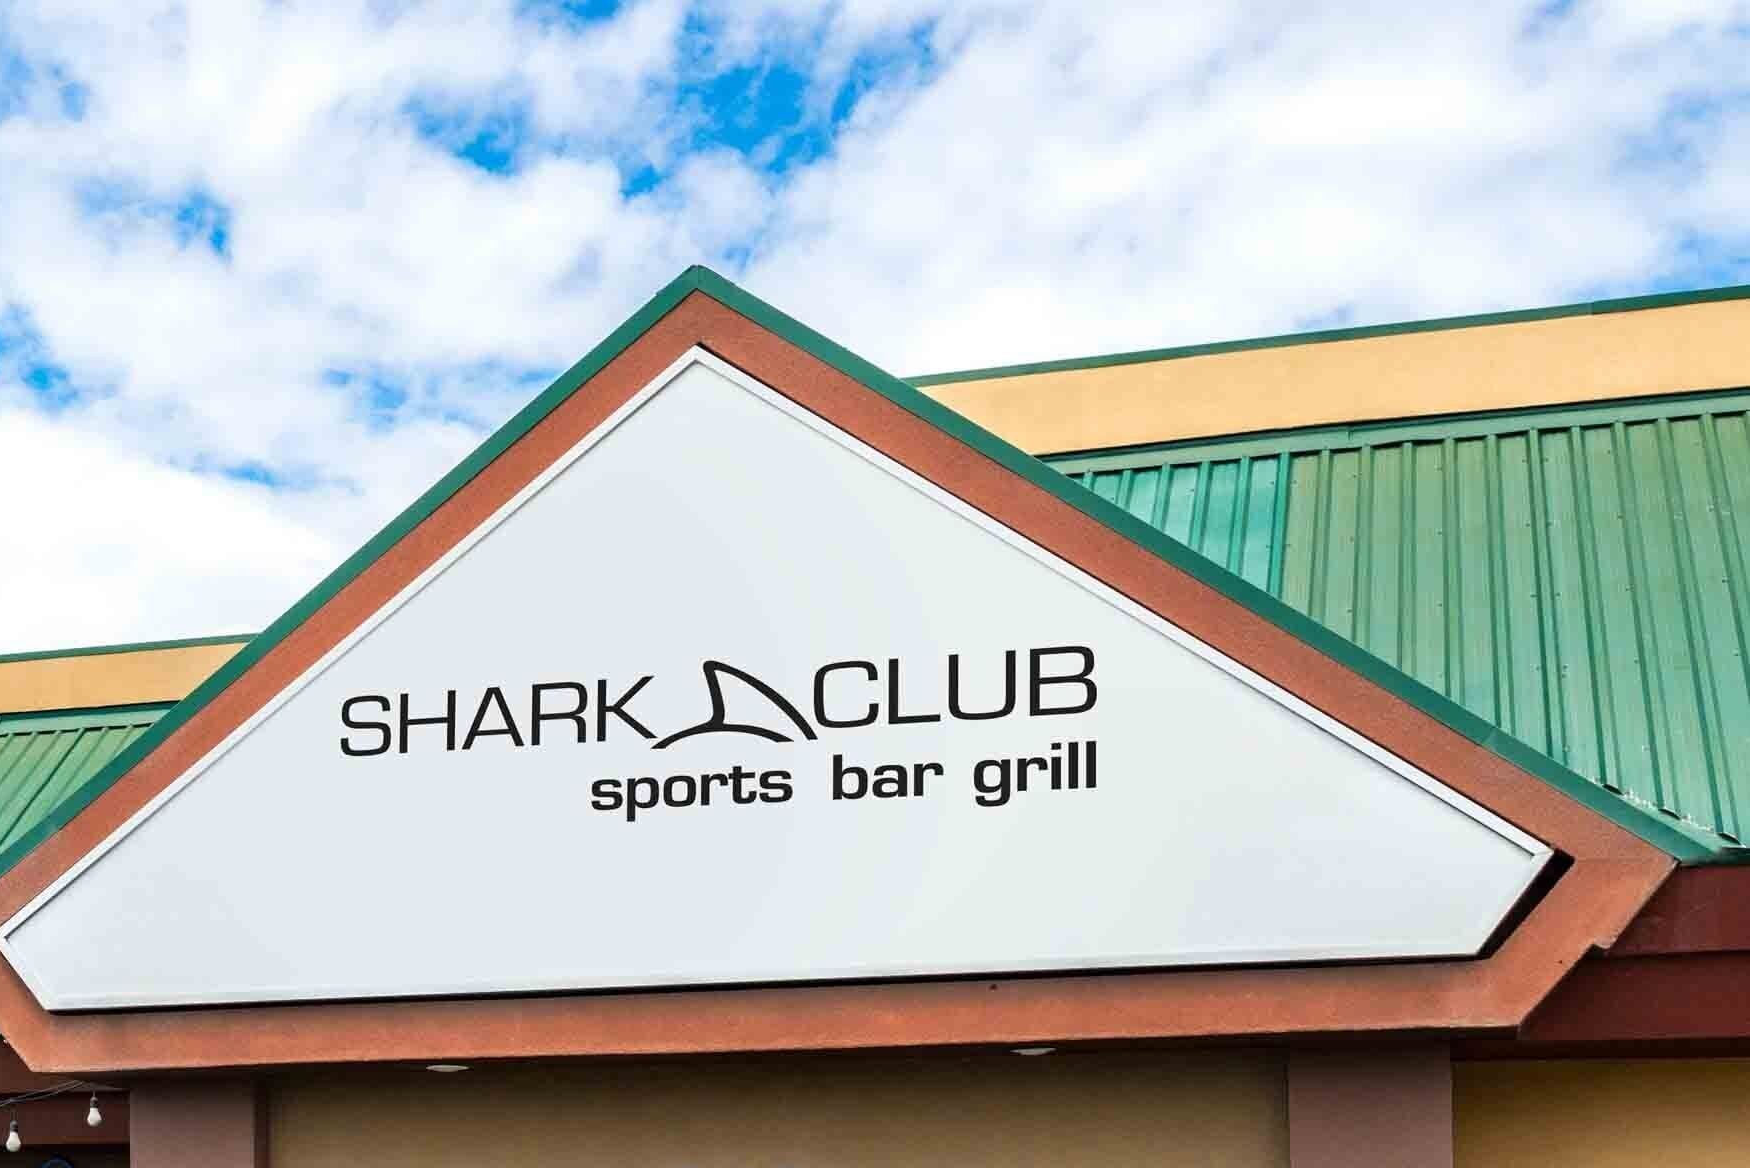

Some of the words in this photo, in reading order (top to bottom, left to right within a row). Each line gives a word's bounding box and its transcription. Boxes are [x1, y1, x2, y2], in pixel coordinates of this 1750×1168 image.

[340, 676, 658, 757] SHARK
[813, 645, 1098, 729] CLUB
[591, 766, 794, 823] sports
[832, 755, 944, 801] bar
[973, 741, 1097, 808] grill
